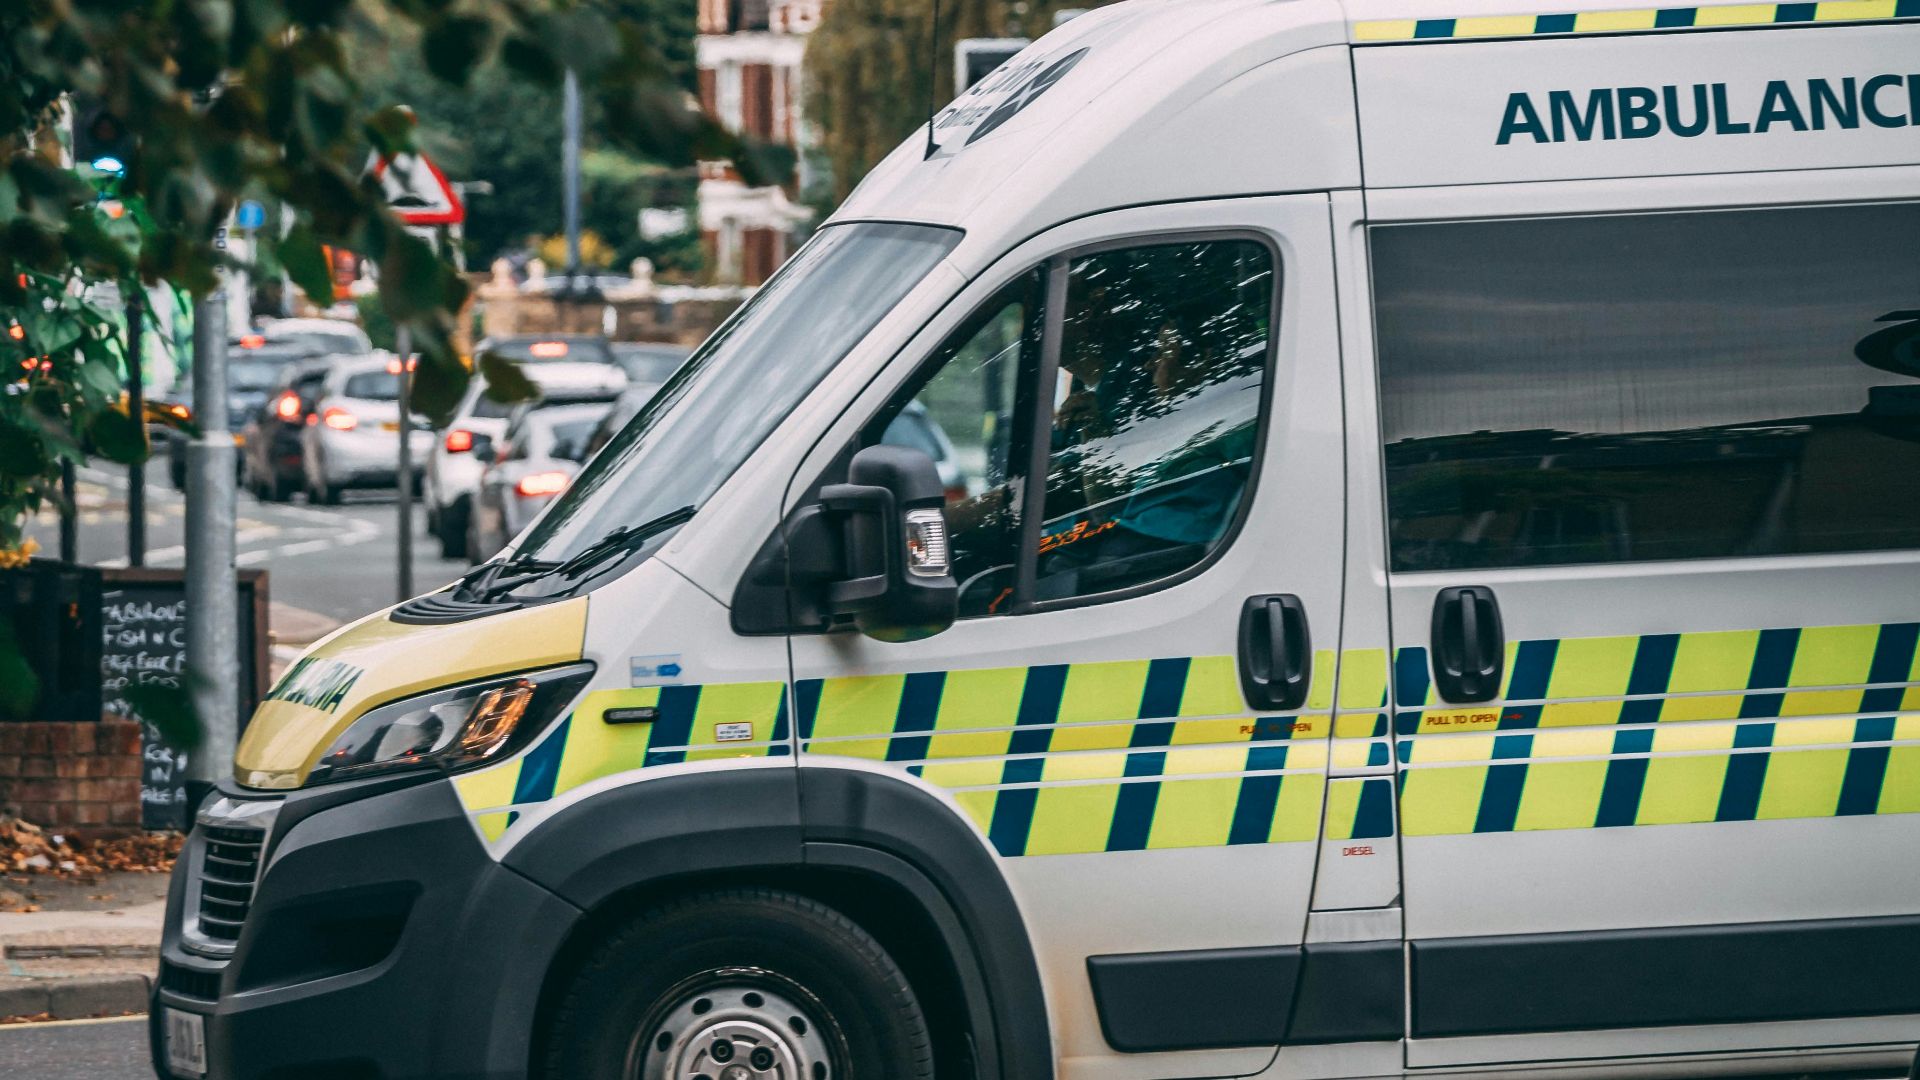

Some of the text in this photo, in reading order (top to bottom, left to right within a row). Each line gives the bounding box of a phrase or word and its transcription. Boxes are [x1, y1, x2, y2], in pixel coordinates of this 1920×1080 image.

[1426, 713, 1499, 726] PULL TO OPEN
[1342, 846, 1376, 857] DIESEL
